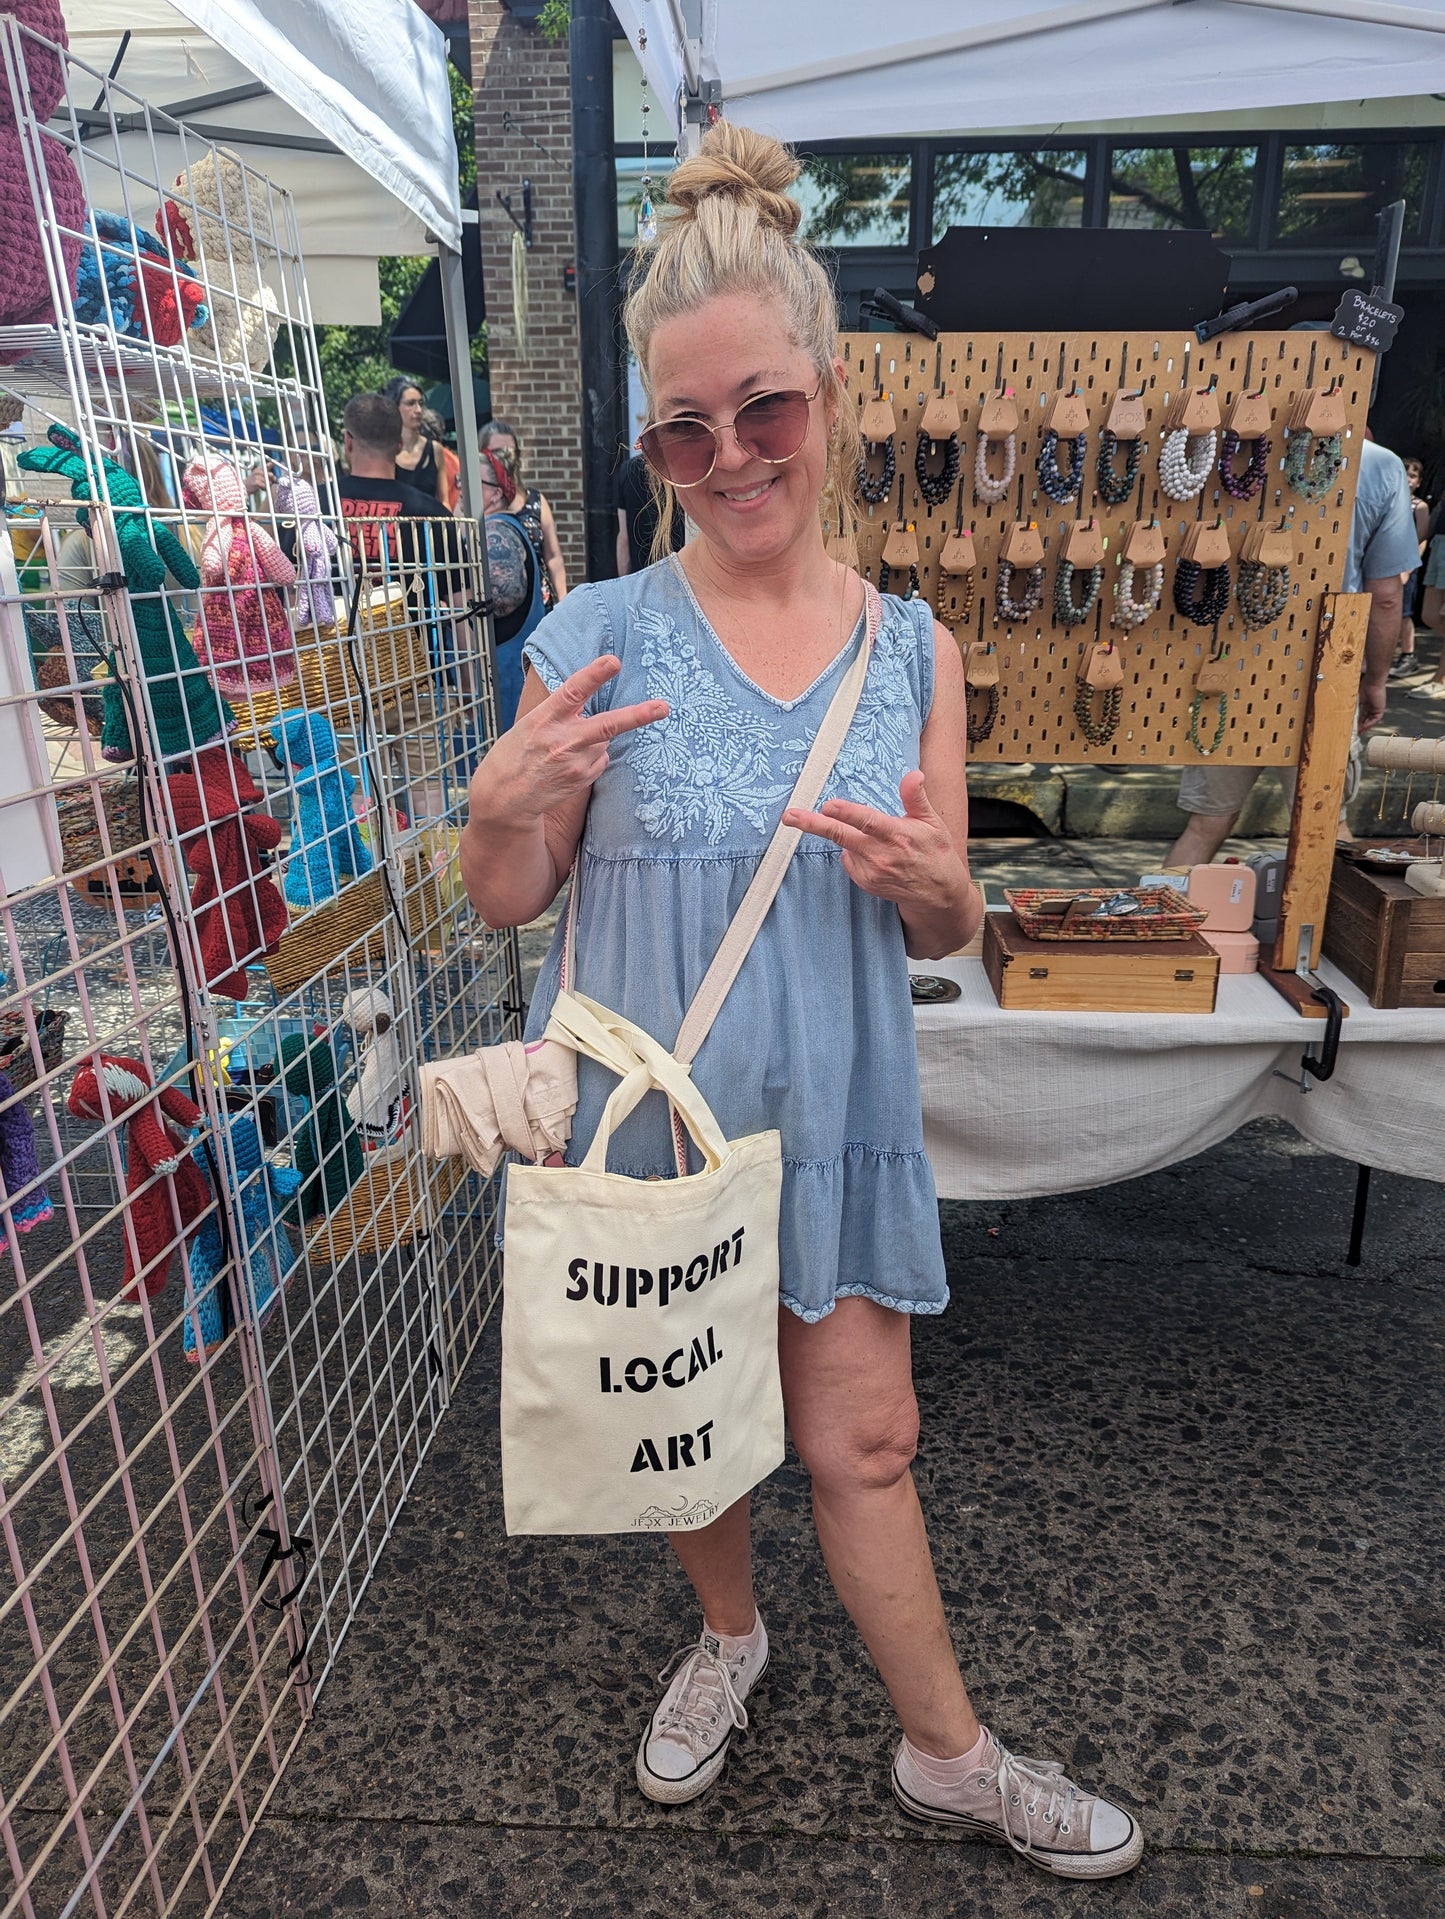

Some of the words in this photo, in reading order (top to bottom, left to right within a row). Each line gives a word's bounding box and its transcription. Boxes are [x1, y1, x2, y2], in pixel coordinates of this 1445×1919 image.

[1354, 295, 1397, 323] BRACELETS
[1358, 312, 1376, 328] $20
[1337, 325, 1346, 336] 2
[1114, 411, 1143, 426] JFOX
[342, 499, 400, 517] DRIFT
[566, 1226, 745, 1308] SUPPORT
[600, 1326, 723, 1393] LOCAL
[630, 1420, 714, 1473] ART
[668, 1502, 720, 1526] JEWELRY
